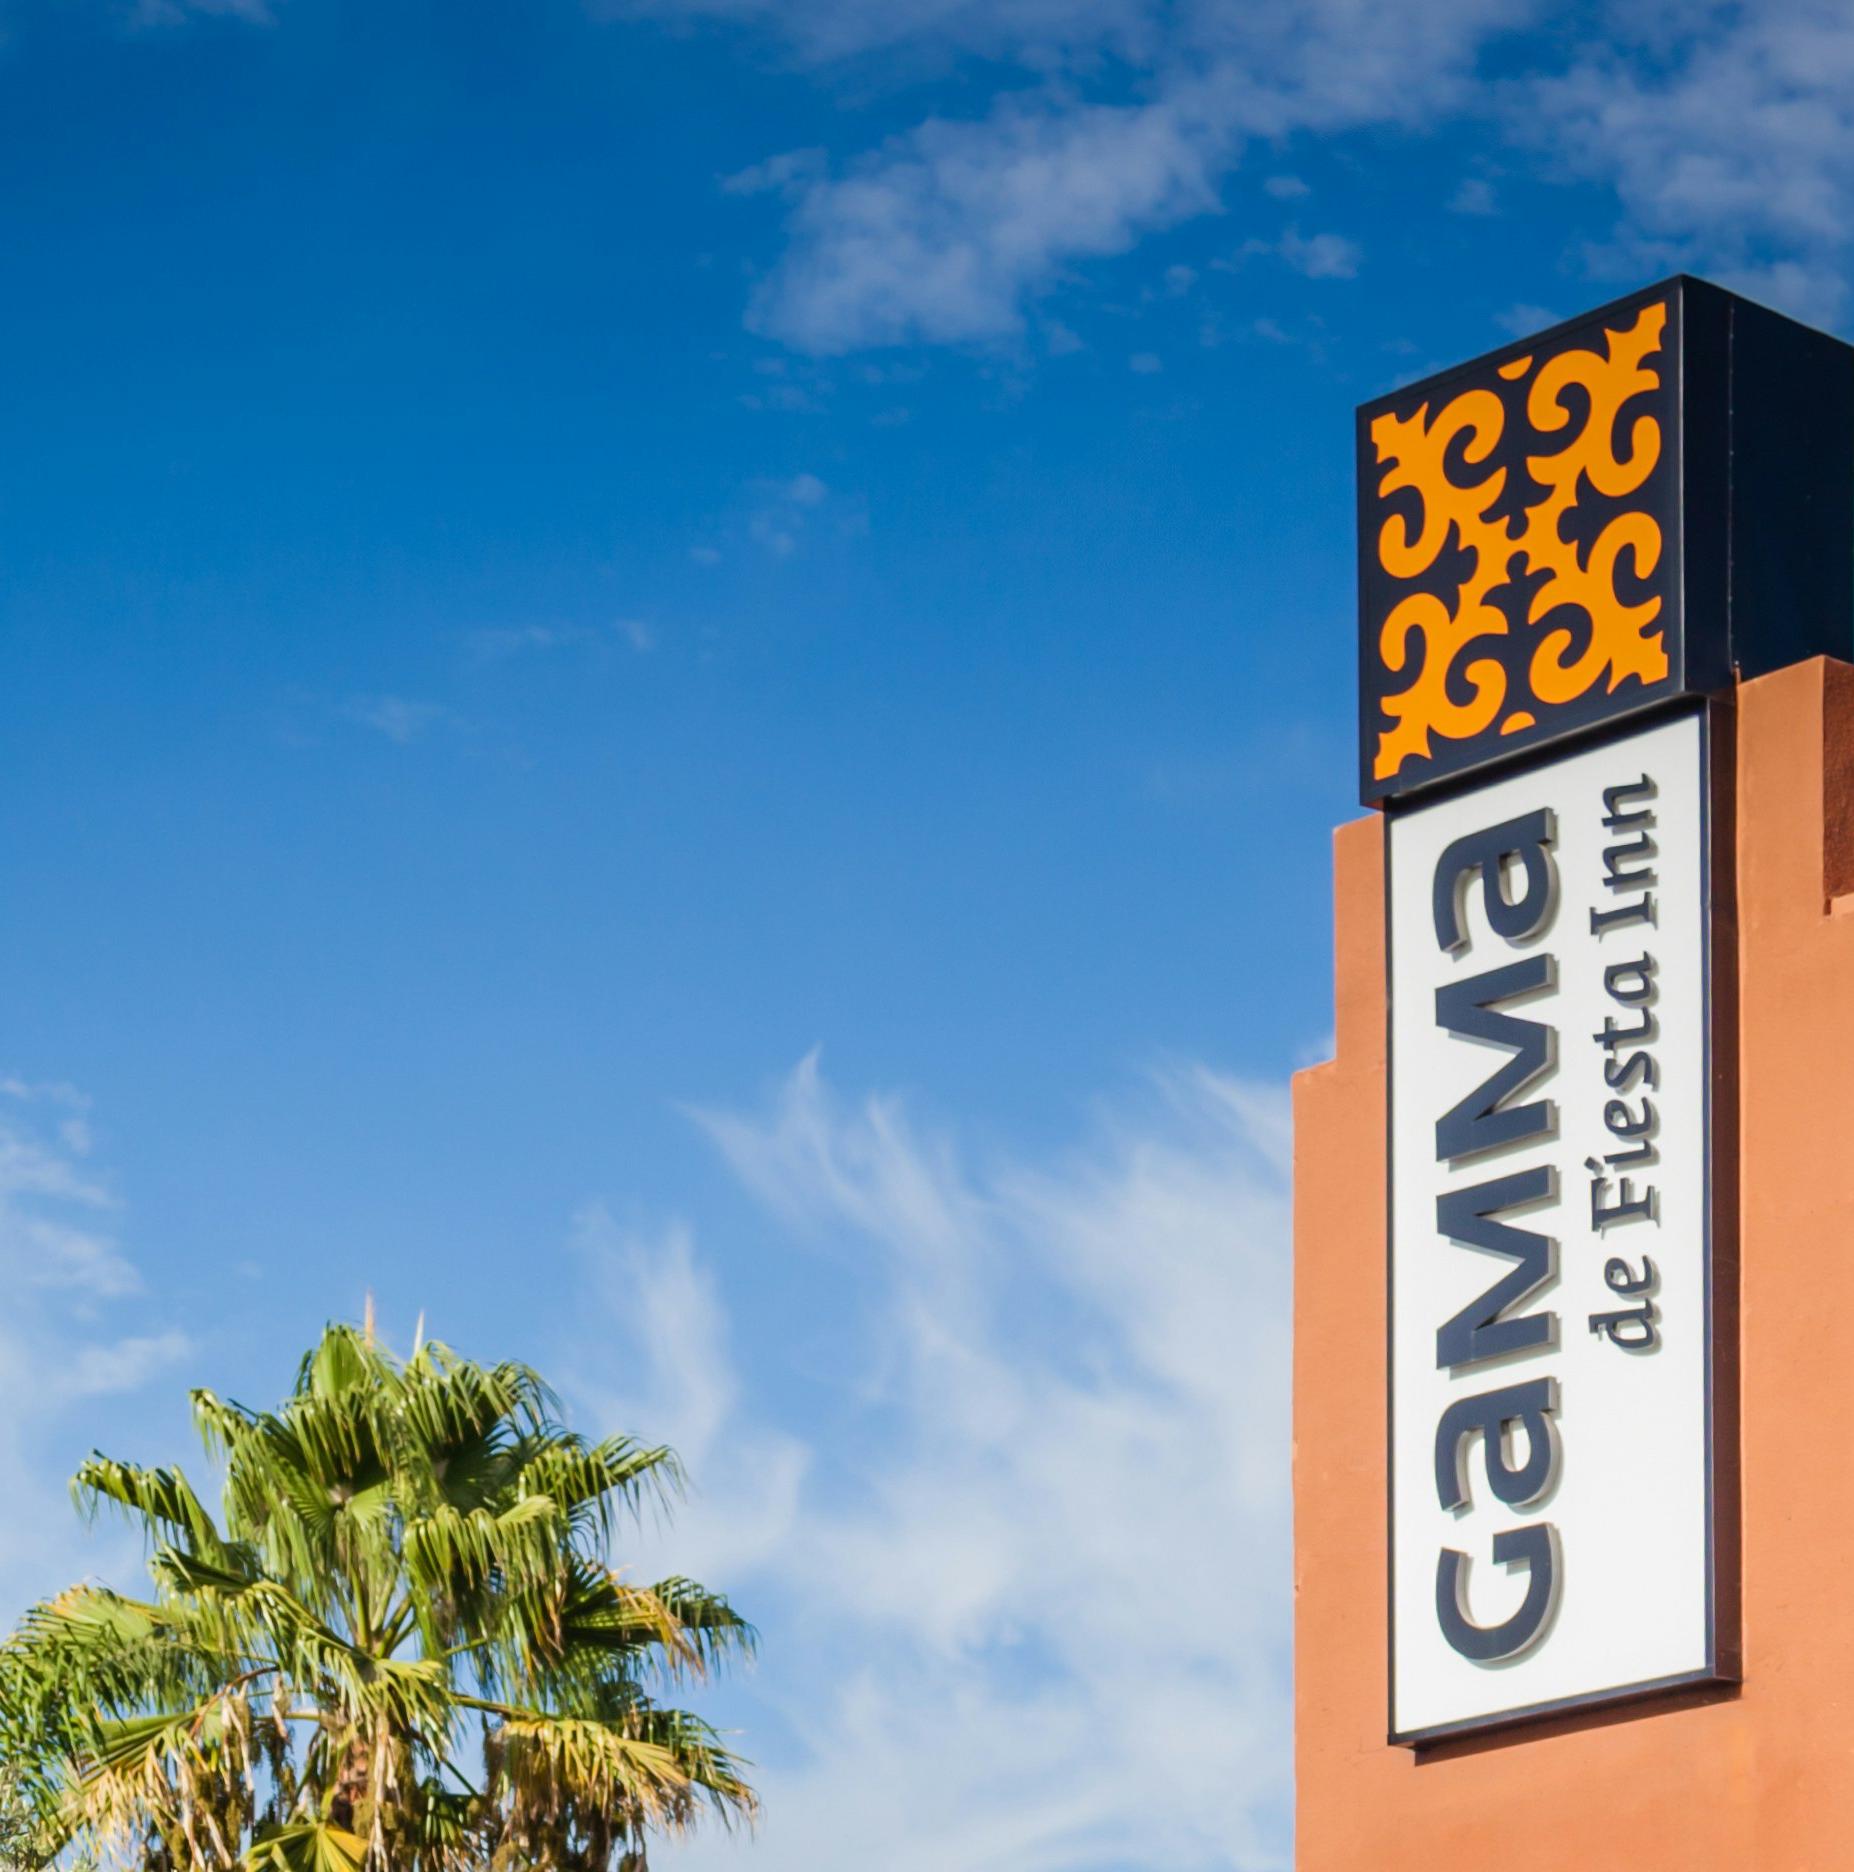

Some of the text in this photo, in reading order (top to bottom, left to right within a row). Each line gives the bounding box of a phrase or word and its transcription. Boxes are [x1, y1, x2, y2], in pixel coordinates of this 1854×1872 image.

[1584, 772, 1658, 1352] de Fiesta Inn
